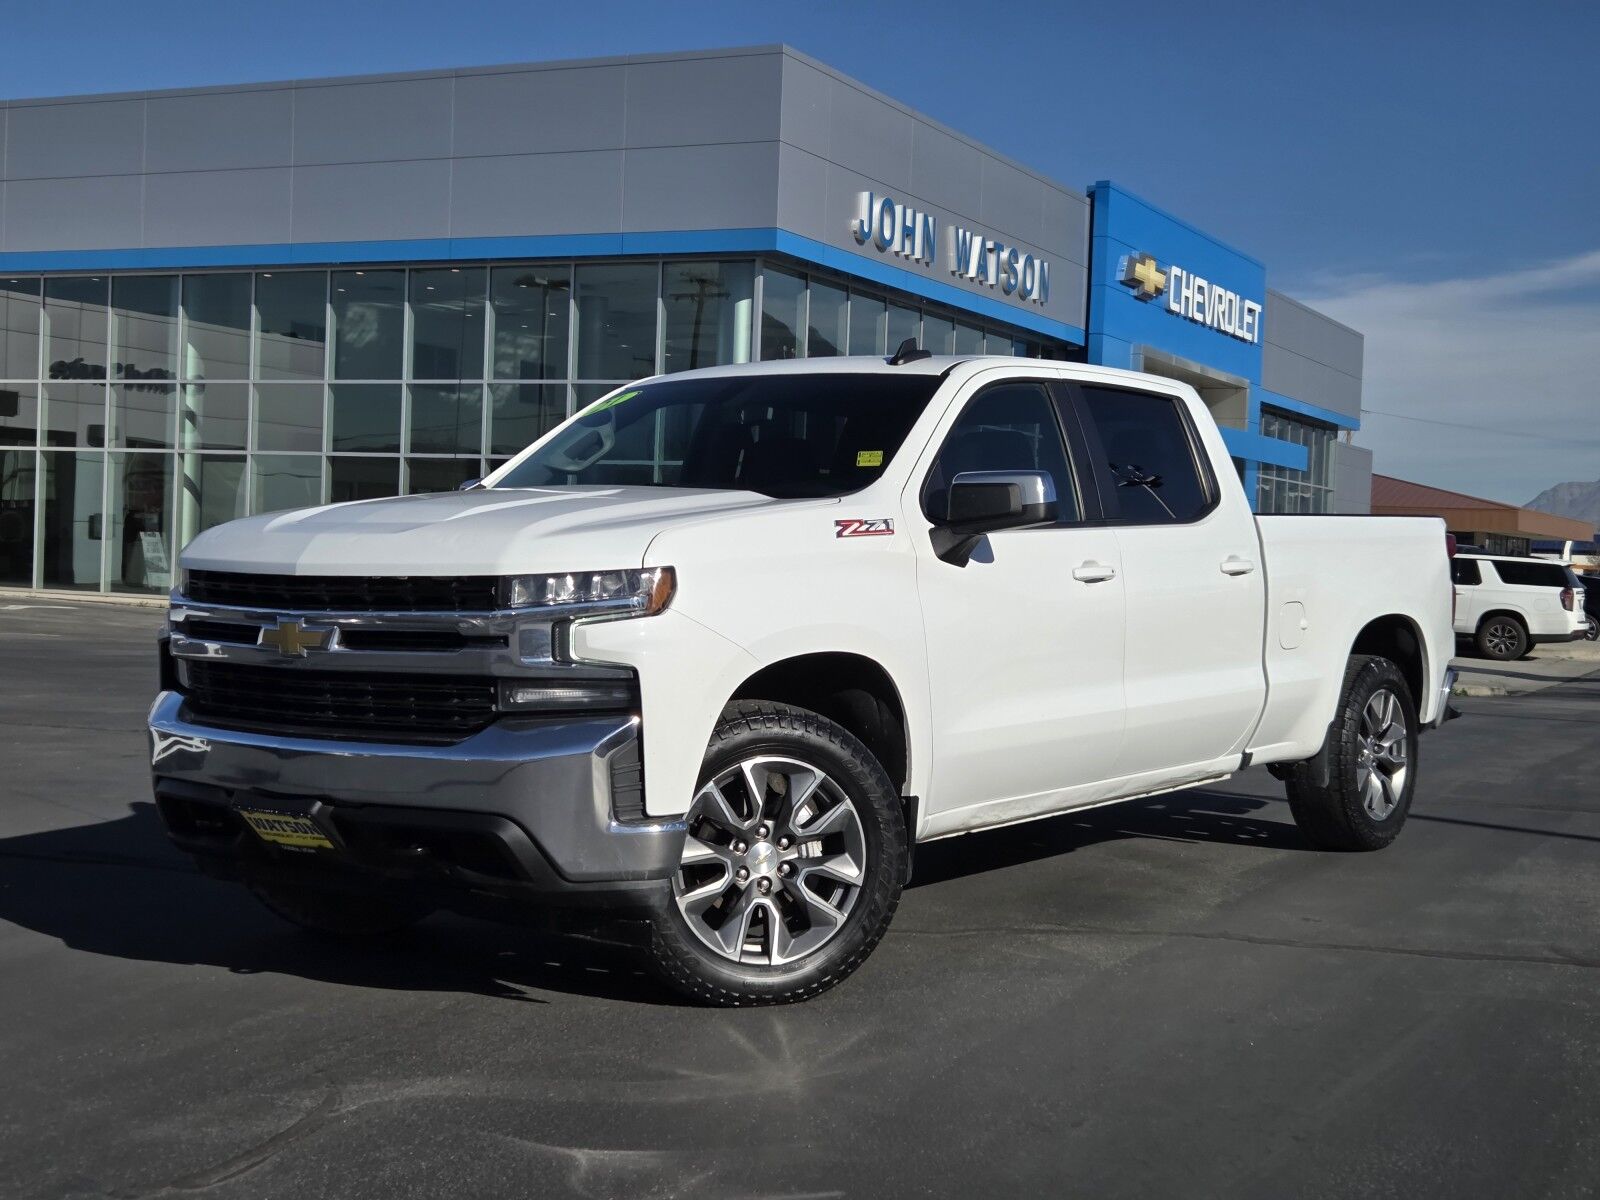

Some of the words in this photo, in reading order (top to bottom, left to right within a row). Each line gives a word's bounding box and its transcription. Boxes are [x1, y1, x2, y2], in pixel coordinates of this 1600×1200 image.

[852, 191, 936, 265] JOHN
[947, 225, 1050, 304] WATSON
[1167, 265, 1262, 343] CHEVROLET
[834, 519, 895, 538] Z71
